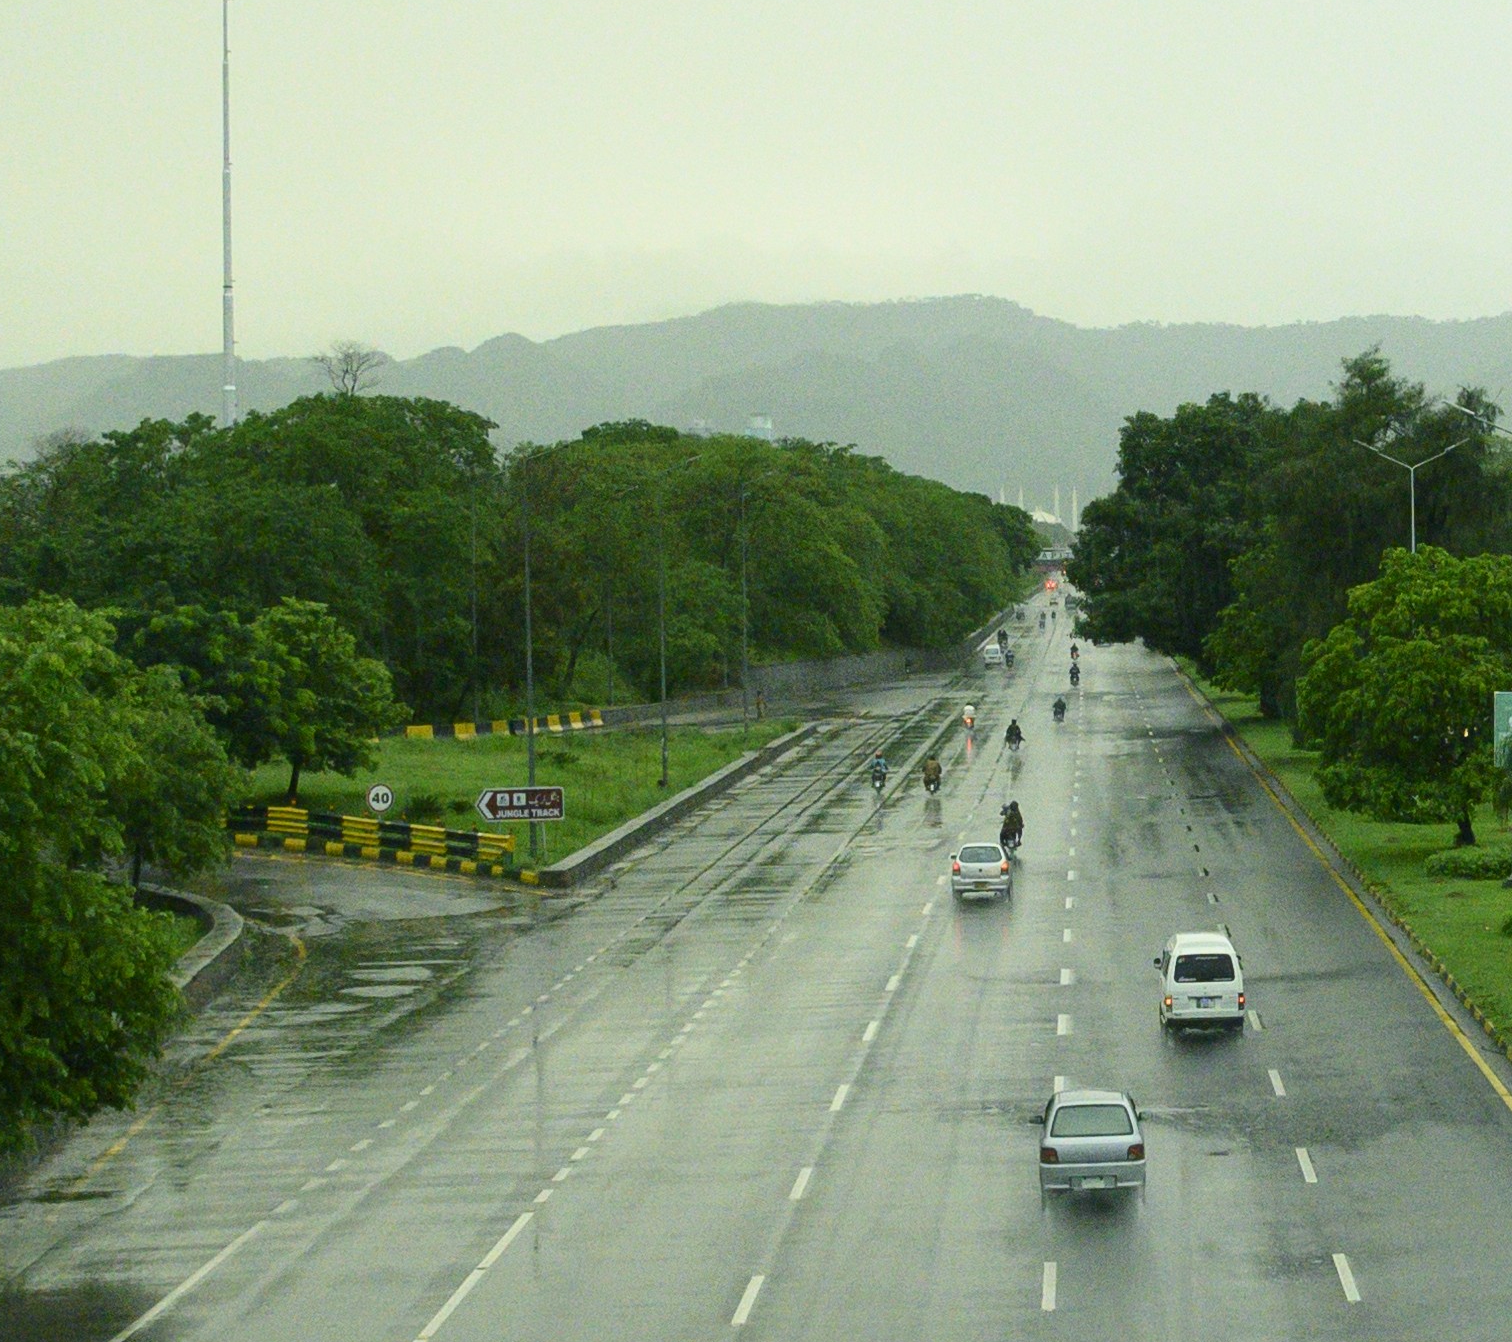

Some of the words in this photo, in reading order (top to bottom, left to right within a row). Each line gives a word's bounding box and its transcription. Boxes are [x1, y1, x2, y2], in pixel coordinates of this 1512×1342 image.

[371, 792, 390, 804] 40
[495, 809, 529, 819] JUNGLE
[531, 808, 561, 818] TRACK
